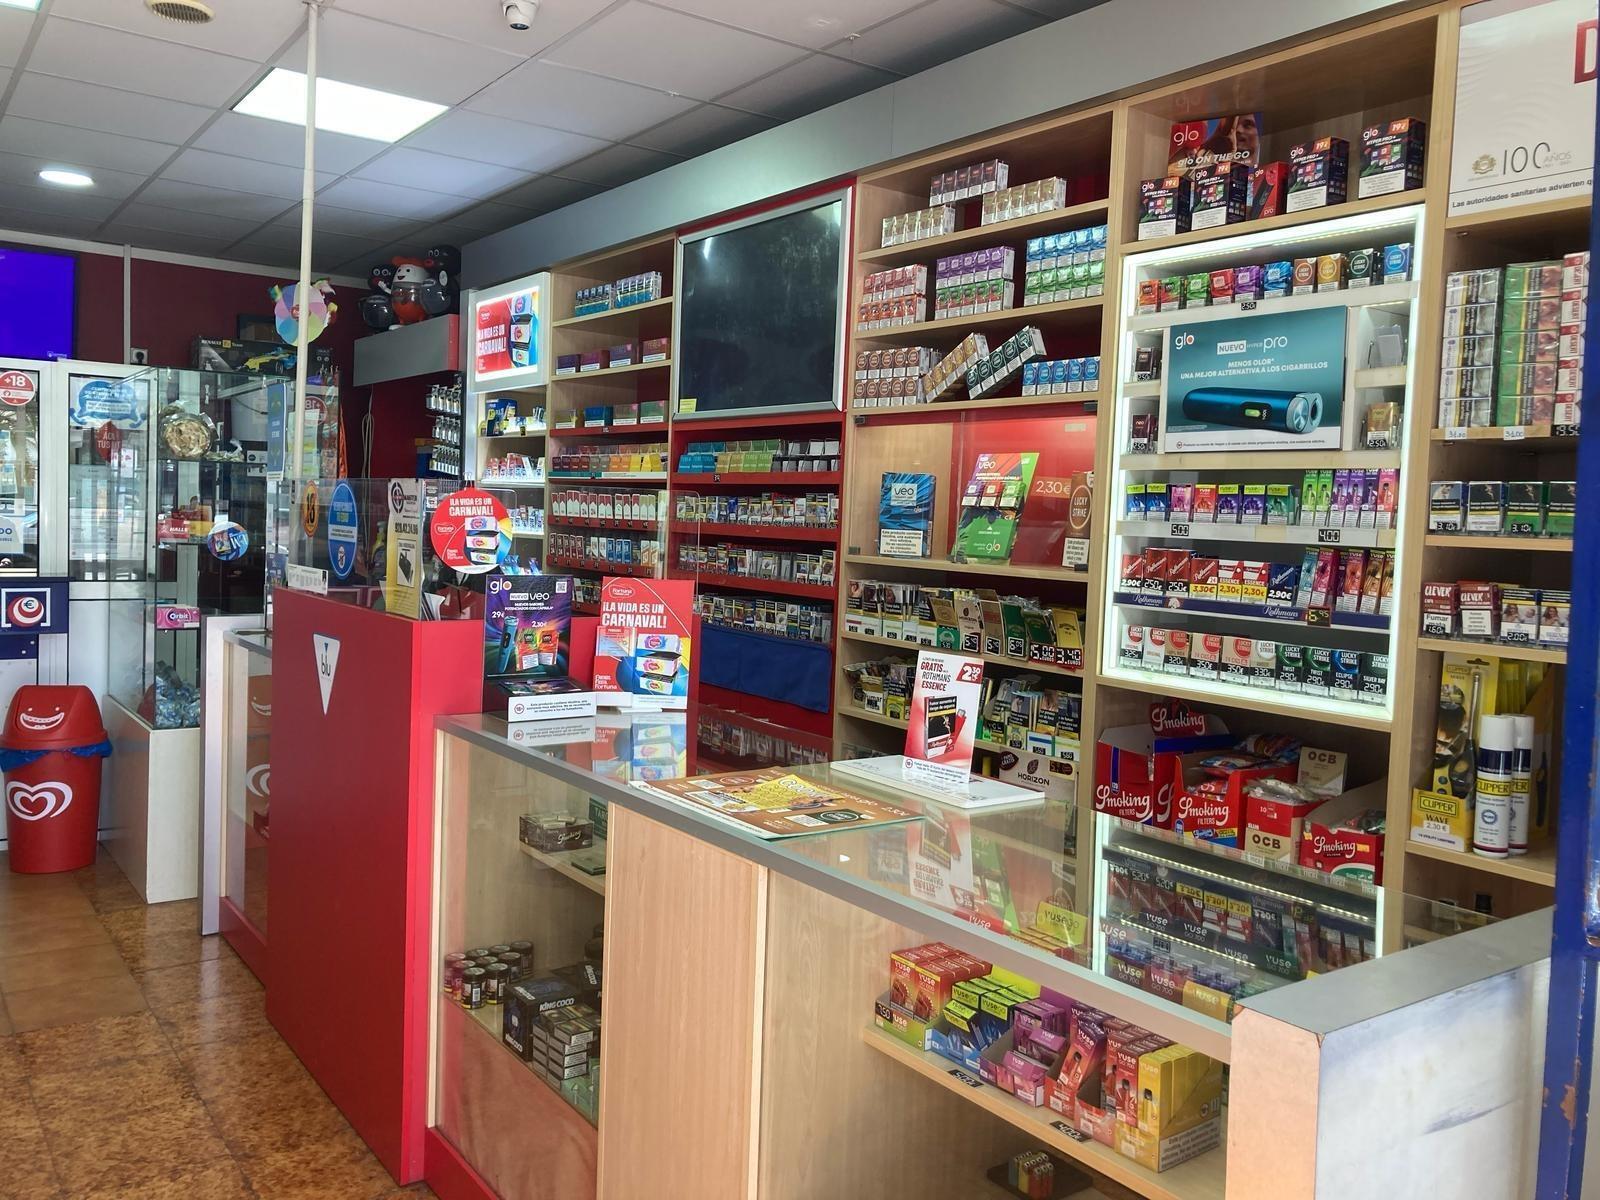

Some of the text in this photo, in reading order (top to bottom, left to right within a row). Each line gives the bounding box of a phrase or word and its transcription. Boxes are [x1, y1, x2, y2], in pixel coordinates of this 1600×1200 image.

[1174, 125, 1199, 146] glo
[1363, 128, 1378, 141] glo
[1196, 155, 1211, 164] ON
[1213, 153, 1234, 162] THE
[1234, 151, 1250, 160] GO
[1290, 147, 1304, 159] glo
[1196, 169, 1207, 180] glo
[1142, 182, 1154, 193] glo
[1466, 193, 1509, 206] autoridades
[1511, 188, 1547, 199] sanitarias
[1548, 181, 1585, 192] advierten
[1175, 332, 1195, 350] glo
[1219, 336, 1288, 353] NUEVO pro
[1228, 360, 1252, 368] MENOS
[1180, 361, 1328, 380] UNA MEJOR ALTERNATIVA LOS CIGARRILLOS
[4, 375, 26, 387] +18
[978, 460, 996, 470] veo
[894, 487, 915, 496] veo
[460, 498, 474, 506] VIDA
[475, 498, 483, 506] ES
[1074, 496, 1088, 506] LUCKY
[449, 505, 494, 517] CARNAVAL!
[1073, 508, 1087, 518] STRIKE
[169, 526, 189, 534] HALLS
[986, 538, 1001, 554] glo
[1169, 557, 1189, 576] Rothmans
[1194, 561, 1216, 581] Rothmans
[1271, 567, 1294, 586] Rothmans
[490, 578, 512, 595] glo
[1121, 579, 1142, 587] 2,90€
[1219, 585, 1240, 595] 2,30€
[1244, 587, 1265, 596] 2,30€
[1267, 590, 1292, 600] 2,90€
[1424, 585, 1452, 598] CLEVER
[530, 592, 550, 601] veo
[1134, 594, 1163, 604] Rothmans
[603, 601, 665, 615] ¡LA VIDA ES UN
[1264, 605, 1298, 618] Rothmans
[168, 613, 189, 621] Orbit
[602, 613, 668, 629] CARNAVAL!
[1426, 614, 1448, 622] Fumar
[1313, 655, 1330, 663] STRIKE
[1314, 649, 1330, 657] LUCKY
[1341, 651, 1356, 659] LUCKY
[921, 661, 944, 673] GRATIS
[1340, 657, 1357, 665] STRIKE
[1371, 661, 1389, 669] STRIKE
[922, 671, 952, 683] ROTHMANS
[1335, 672, 1353, 680] ECLIPSE
[1363, 675, 1378, 683] SILVER
[921, 681, 947, 692] ESSENCE
[1151, 707, 1206, 736] Smoking
[1308, 751, 1337, 765] OCB
[1017, 772, 1050, 787] HORIZON
[1095, 784, 1151, 819] Smoking
[1422, 798, 1454, 813] CLIPPER
[1119, 808, 1136, 816] FILTERS
[1178, 796, 1229, 827] Smoking
[1197, 817, 1216, 825] FILTERS
[1426, 813, 1449, 825] WAVE
[1252, 833, 1281, 850] OCB
[1313, 835, 1356, 859] Smoking
[969, 915, 992, 930] vuse
[1044, 911, 1066, 924] vuse
[1146, 912, 1168, 926] vuse
[1101, 922, 1127, 940] vuse
[1184, 923, 1208, 937] vuse
[894, 960, 911, 973] vuse
[1265, 954, 1292, 969] vuse
[1117, 963, 1142, 979] vuse
[1118, 973, 1129, 981] GO
[919, 973, 936, 986] vuse
[1151, 973, 1176, 989] vuse
[953, 988, 969, 999] vuse
[1151, 983, 1173, 996] GO 700
[539, 998, 575, 1012] KING COCO
[982, 1000, 998, 1011] vuse
[1078, 1029, 1095, 1046] vuse
[1118, 1052, 1137, 1064] vuse
